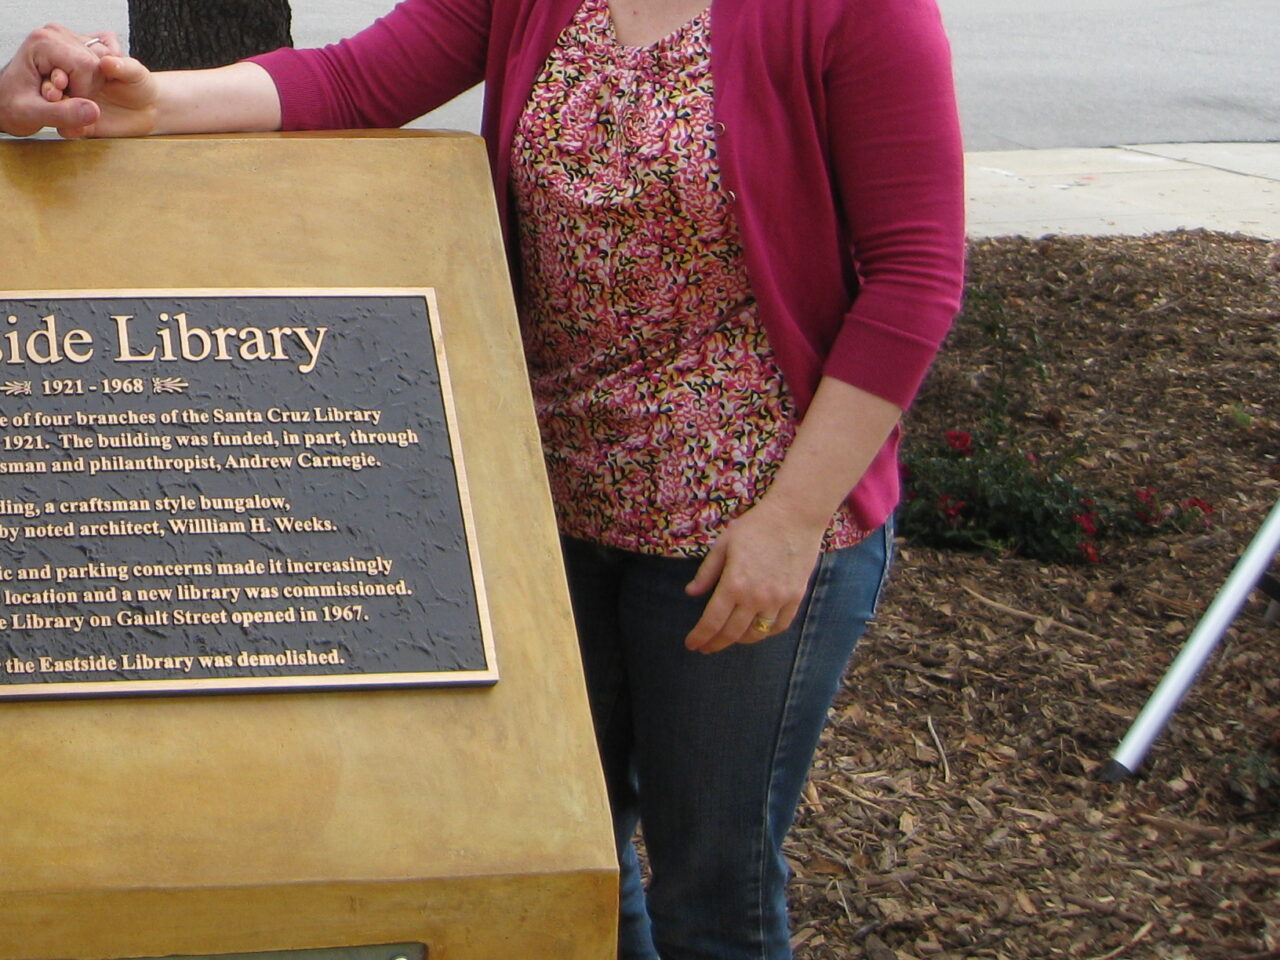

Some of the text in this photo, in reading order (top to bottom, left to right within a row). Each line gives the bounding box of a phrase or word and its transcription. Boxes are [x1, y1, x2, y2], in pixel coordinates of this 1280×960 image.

[110, 312, 328, 374] Library
[42, 378, 84, 394] 1921
[101, 377, 144, 393] 1968
[12, 411, 31, 427] of
[34, 411, 72, 426] four
[75, 410, 156, 425] branches
[160, 409, 179, 423] of
[181, 409, 209, 423] the
[212, 408, 263, 423] Santa
[266, 408, 311, 422] Cruz
[313, 407, 381, 425] Library
[3, 435, 50, 450] 1921.
[58, 434, 93, 448] The
[96, 433, 172, 450] building
[174, 434, 209, 446] was
[212, 431, 279, 447] funded,
[282, 430, 300, 445] in
[303, 430, 347, 448] part,
[349, 428, 419, 447] through
[51, 458, 85, 472] and
[88, 455, 221, 475] philanthropist,
[224, 454, 293, 468] Andrew
[296, 452, 381, 470] Carnegie.
[44, 501, 55, 513] a
[59, 497, 151, 513] craftsman
[154, 496, 196, 514] style
[199, 495, 290, 513] bungalow,
[23, 522, 75, 537] noted
[79, 520, 165, 537] architect,
[249, 518, 272, 533] H.
[274, 517, 337, 532] Weeks.
[17, 564, 51, 580] and
[55, 563, 129, 582] parking
[132, 563, 212, 577] concerns
[216, 559, 265, 575] made
[268, 559, 283, 574] it
[286, 557, 392, 576] increasingly
[4, 589, 78, 604] location
[82, 587, 117, 602] and
[121, 589, 132, 601] a
[136, 588, 173, 601] new
[176, 585, 241, 603] library
[243, 586, 279, 598] was
[282, 580, 412, 598] commissioned.
[10, 613, 84, 632] Library
[89, 615, 112, 627] on
[116, 610, 169, 626] Gault
[172, 609, 228, 624] Street
[231, 607, 296, 628] opened
[299, 607, 318, 622] in
[322, 605, 369, 621] 1967.
[4, 657, 35, 673] the
[38, 654, 117, 672] Eastside
[120, 653, 194, 672] Library
[197, 654, 233, 668] was
[236, 648, 345, 667] demolished.
